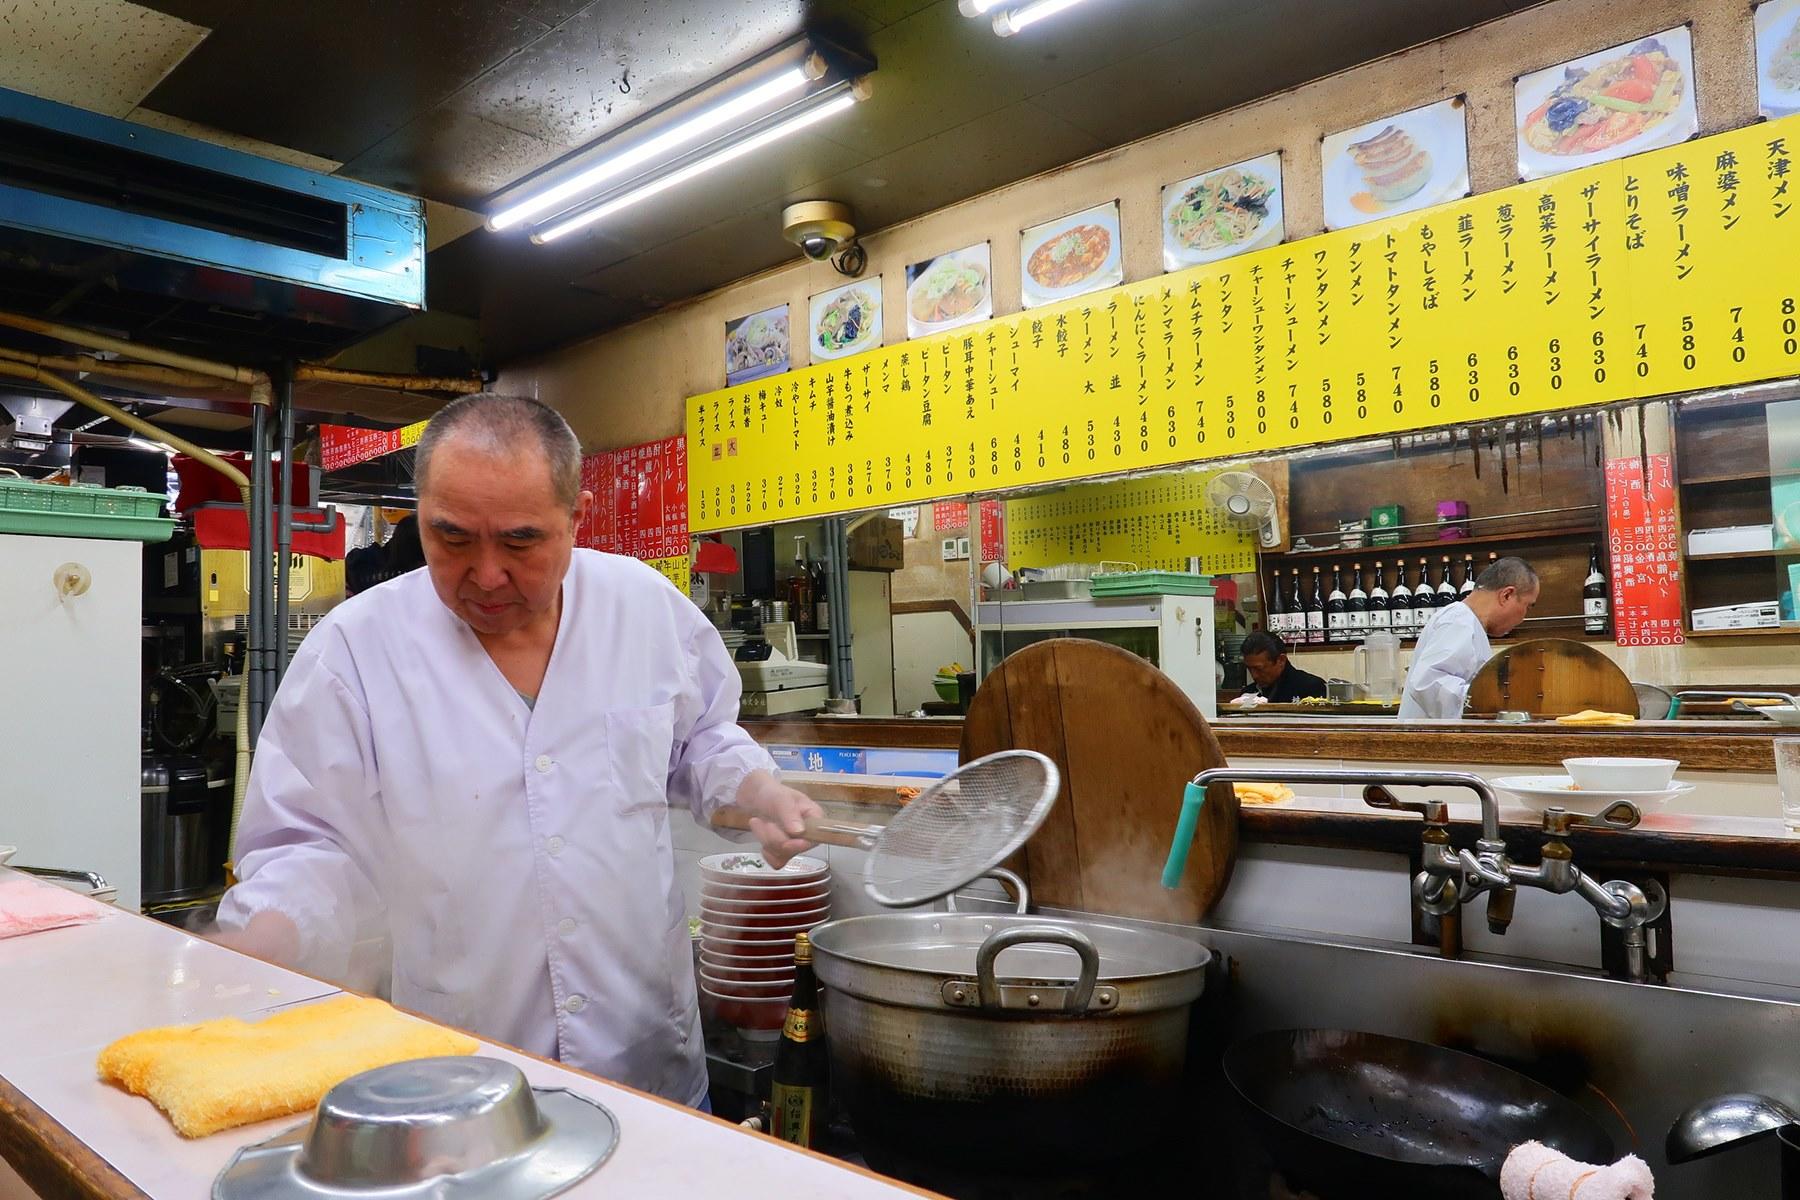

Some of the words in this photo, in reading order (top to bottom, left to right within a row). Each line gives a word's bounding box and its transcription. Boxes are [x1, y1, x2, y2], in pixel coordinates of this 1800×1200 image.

[1624, 175, 1647, 251] とりそば
[1420, 224, 1440, 311] もやしそば
[1537, 194, 1561, 306] 高菜ラーメン
[1579, 180, 1606, 321] ザーサイラーメン
[1665, 162, 1694, 281] 味噌ラーメン
[1681, 315, 1696, 371] 580
[1714, 150, 1741, 231] 麻婆メン
[1729, 306, 1746, 363] 740
[1765, 137, 1793, 219] 天津メン
[1781, 297, 1798, 355] 800
[1281, 257, 1299, 371] チャーシューメン
[1383, 234, 1403, 350] トマトタンメン
[1495, 203, 1518, 295] 葱ラーメン
[1507, 345, 1520, 397] 630
[1031, 319, 1044, 349] 餃子
[1055, 313, 1069, 358] 水餃子
[1081, 307, 1094, 364] ラーメン
[1107, 301, 1120, 358] ラーメン
[1133, 295, 1149, 406] にんにくラーメン
[1161, 288, 1177, 391] メンマラーメン
[1189, 281, 1206, 387] キムチラーメン
[1249, 264, 1267, 385] チャーシューワンタンメン
[1314, 250, 1331, 346] ワンタンメン
[1323, 378, 1332, 425] 580
[1349, 242, 1365, 307] タンメン
[1357, 372, 1366, 420] 580
[1634, 323, 1649, 378] 740
[985, 331, 999, 411] チャーシュー
[1010, 327, 1019, 392] シューマイ
[1109, 374, 1122, 390] 並
[1219, 273, 1233, 334] ワンタン
[1227, 395, 1235, 439] 530
[1429, 359, 1441, 408] 580
[1467, 352, 1480, 403] 630
[1548, 338, 1562, 390] 630
[1592, 330, 1606, 384] 630
[759, 389, 767, 434] 梅キュー
[775, 385, 783, 408] 冷奴
[791, 380, 799, 451] 冷やしトマト
[862, 361, 871, 413] ザーサイ
[1084, 380, 1096, 394] 大
[1257, 389, 1266, 434] 800
[1289, 384, 1298, 430] 740
[1391, 366, 1404, 414] 740
[1140, 410, 1148, 452] 480
[1168, 405, 1176, 448] 630
[1196, 400, 1205, 444] 740
[664, 440, 674, 481] ビール
[676, 437, 686, 494] 黒ビール
[808, 752, 823, 772] 地
